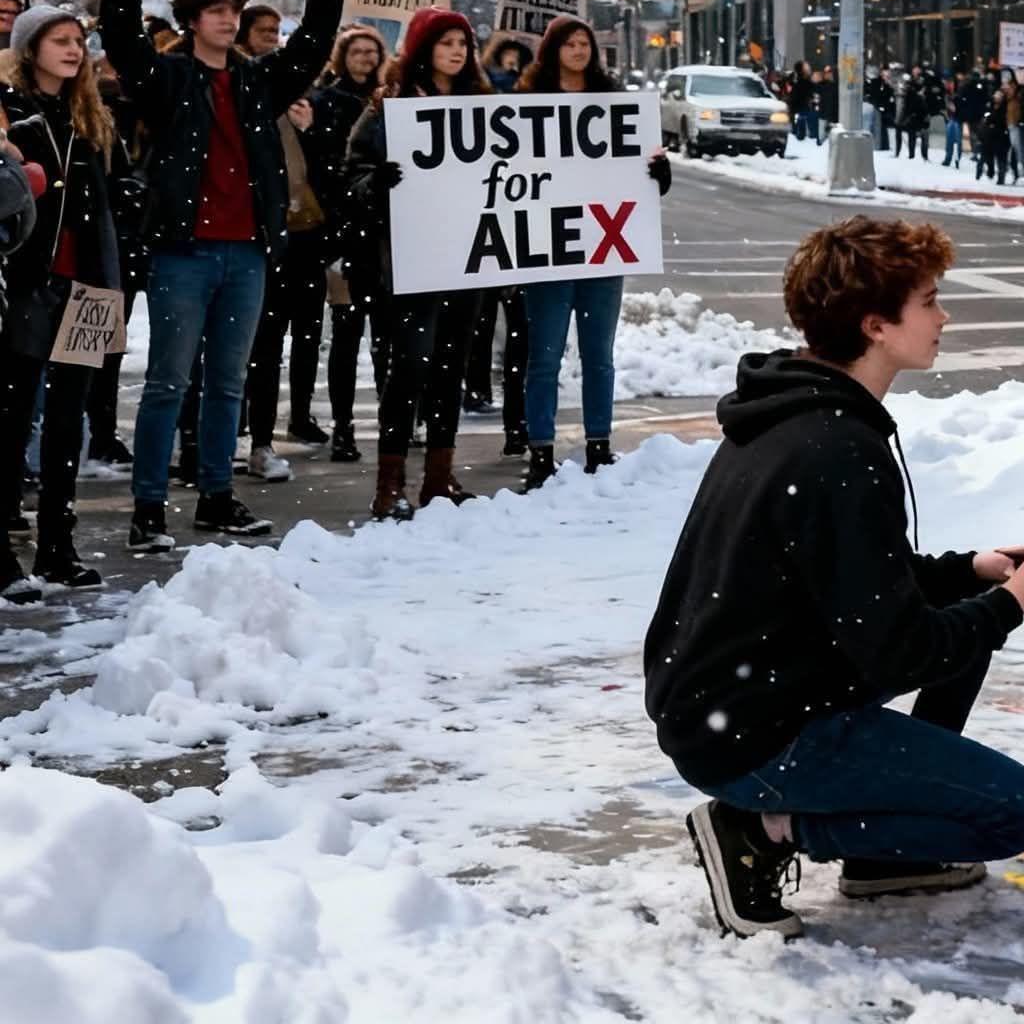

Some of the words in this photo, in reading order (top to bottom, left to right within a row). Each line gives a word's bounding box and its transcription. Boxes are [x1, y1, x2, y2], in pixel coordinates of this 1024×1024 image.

[412, 103, 641, 170] JUSTICE
[482, 160, 552, 209] for
[464, 201, 640, 275] ALEX
